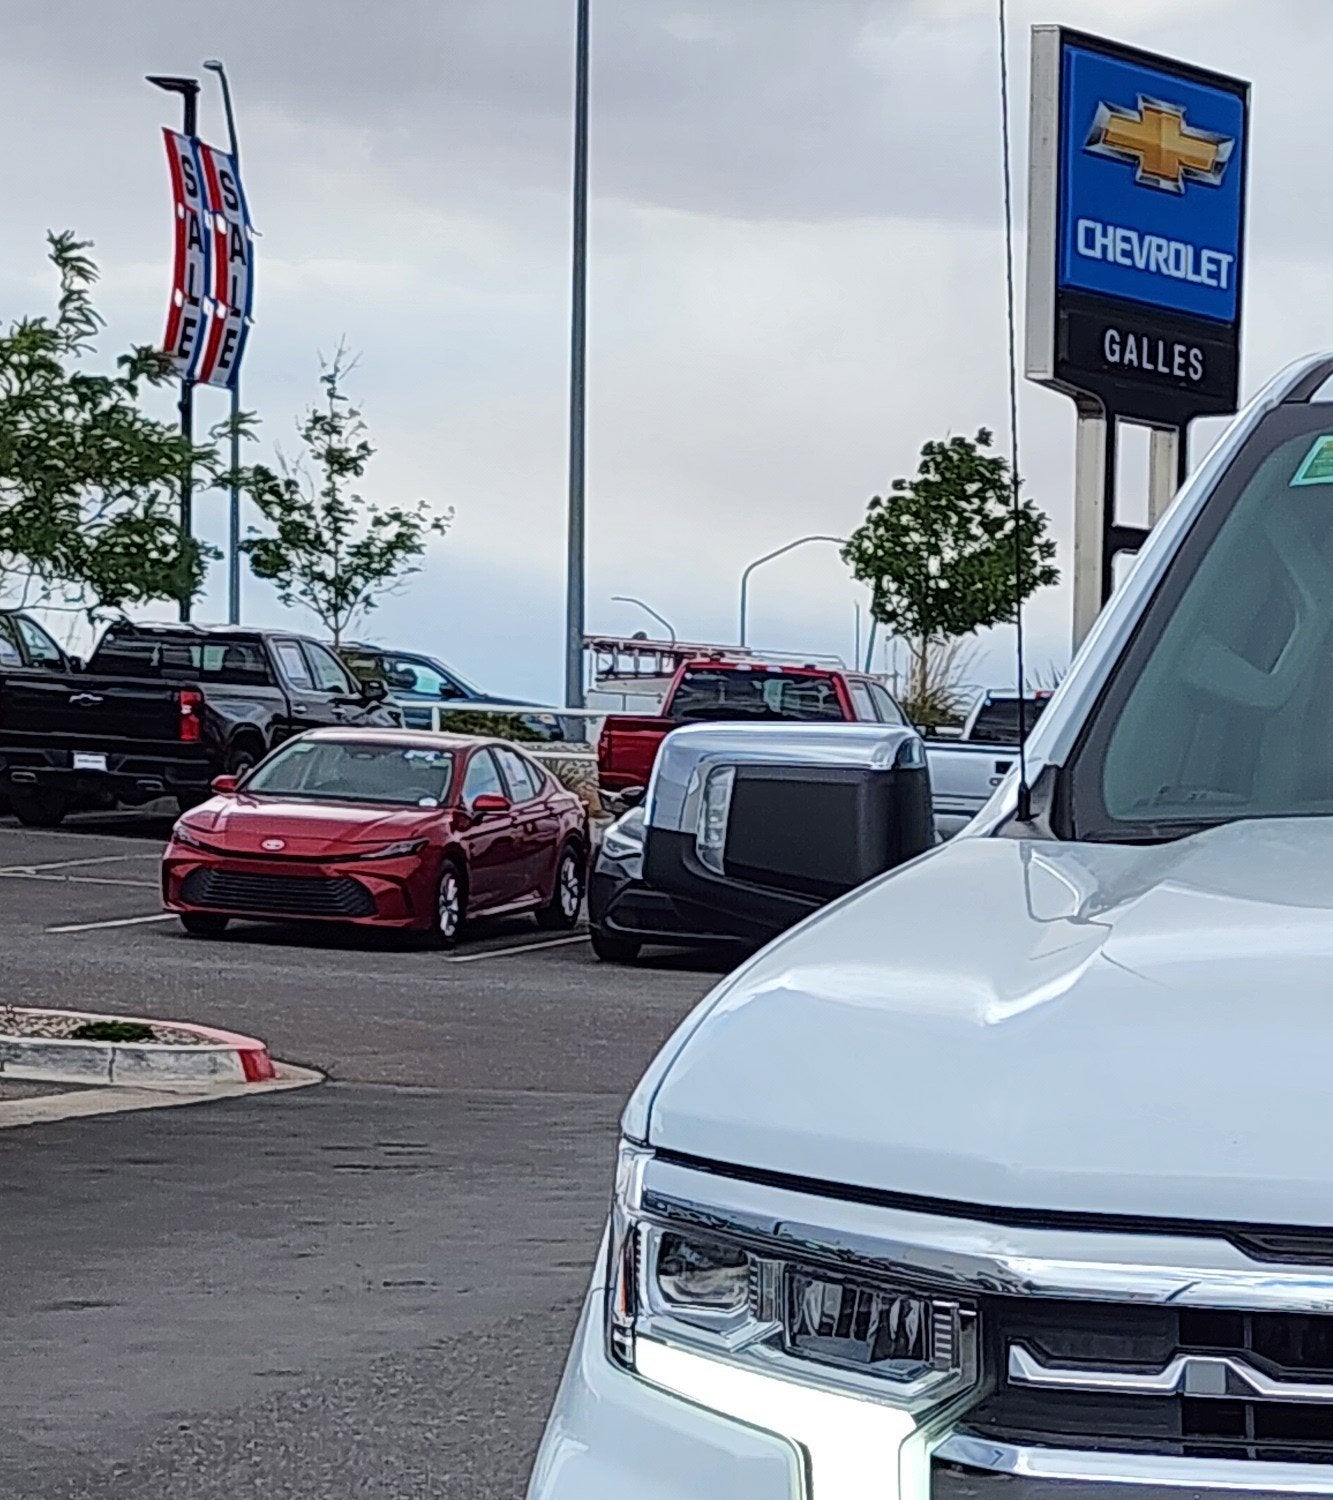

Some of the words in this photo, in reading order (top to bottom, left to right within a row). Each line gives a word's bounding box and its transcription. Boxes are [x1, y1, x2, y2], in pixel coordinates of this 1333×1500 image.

[178, 154, 205, 359] SALE
[218, 168, 246, 368] SALE
[1077, 218, 1233, 289] CHEVROLET
[1104, 328, 1203, 381] GALLES
